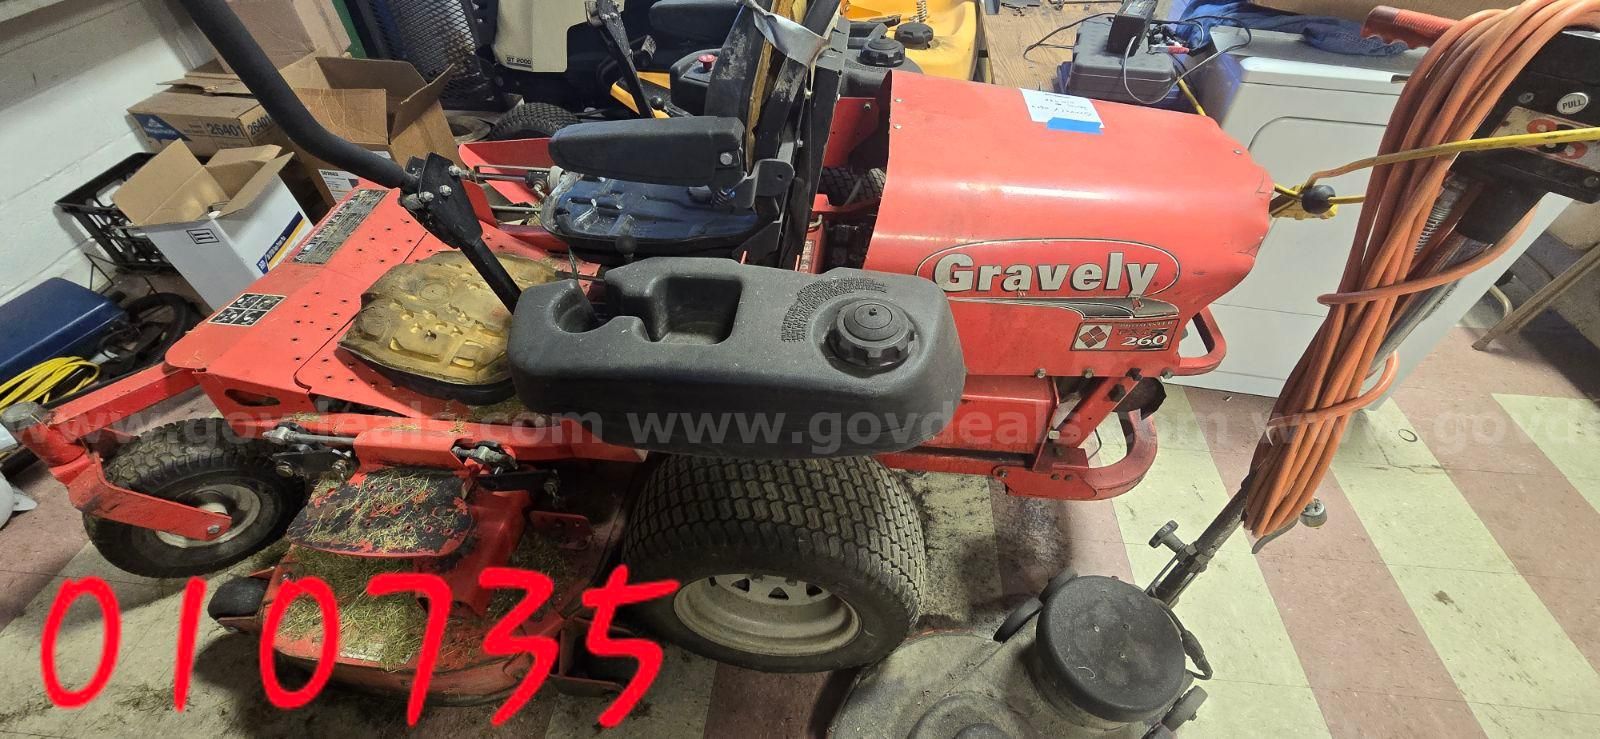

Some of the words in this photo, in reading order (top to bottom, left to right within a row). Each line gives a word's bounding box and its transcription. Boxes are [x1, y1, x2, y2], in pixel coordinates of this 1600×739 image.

[1562, 99, 1583, 110] PULL
[207, 123, 245, 137] 26401
[247, 115, 272, 135] 26401
[934, 252, 1159, 300] Gravely
[1121, 334, 1168, 347] 260
